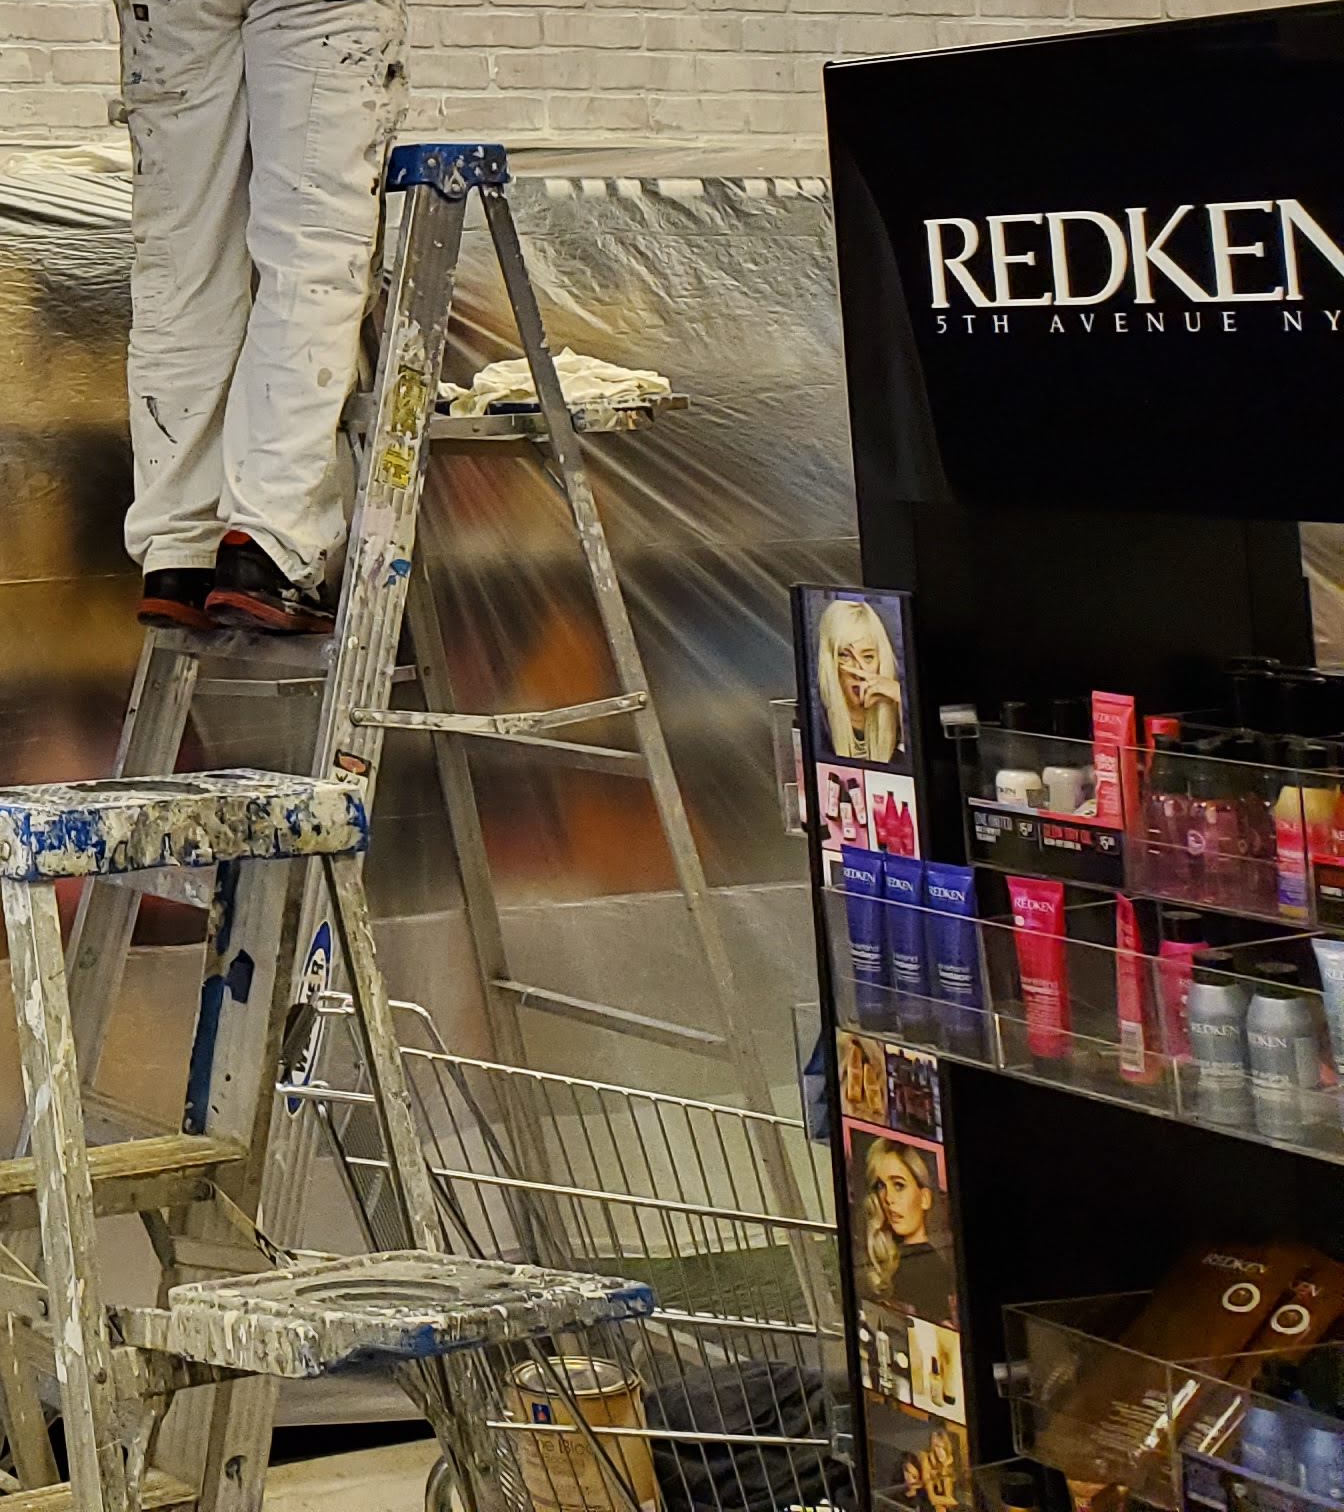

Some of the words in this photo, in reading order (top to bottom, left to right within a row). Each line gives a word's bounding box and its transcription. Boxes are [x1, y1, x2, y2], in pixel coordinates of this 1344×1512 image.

[923, 198, 1344, 309] REDKEN
[936, 312, 1010, 335] 5TH
[1049, 311, 1238, 334] AVENUE
[928, 885, 966, 902] REDKEN
[1014, 897, 1055, 913] REDKEN
